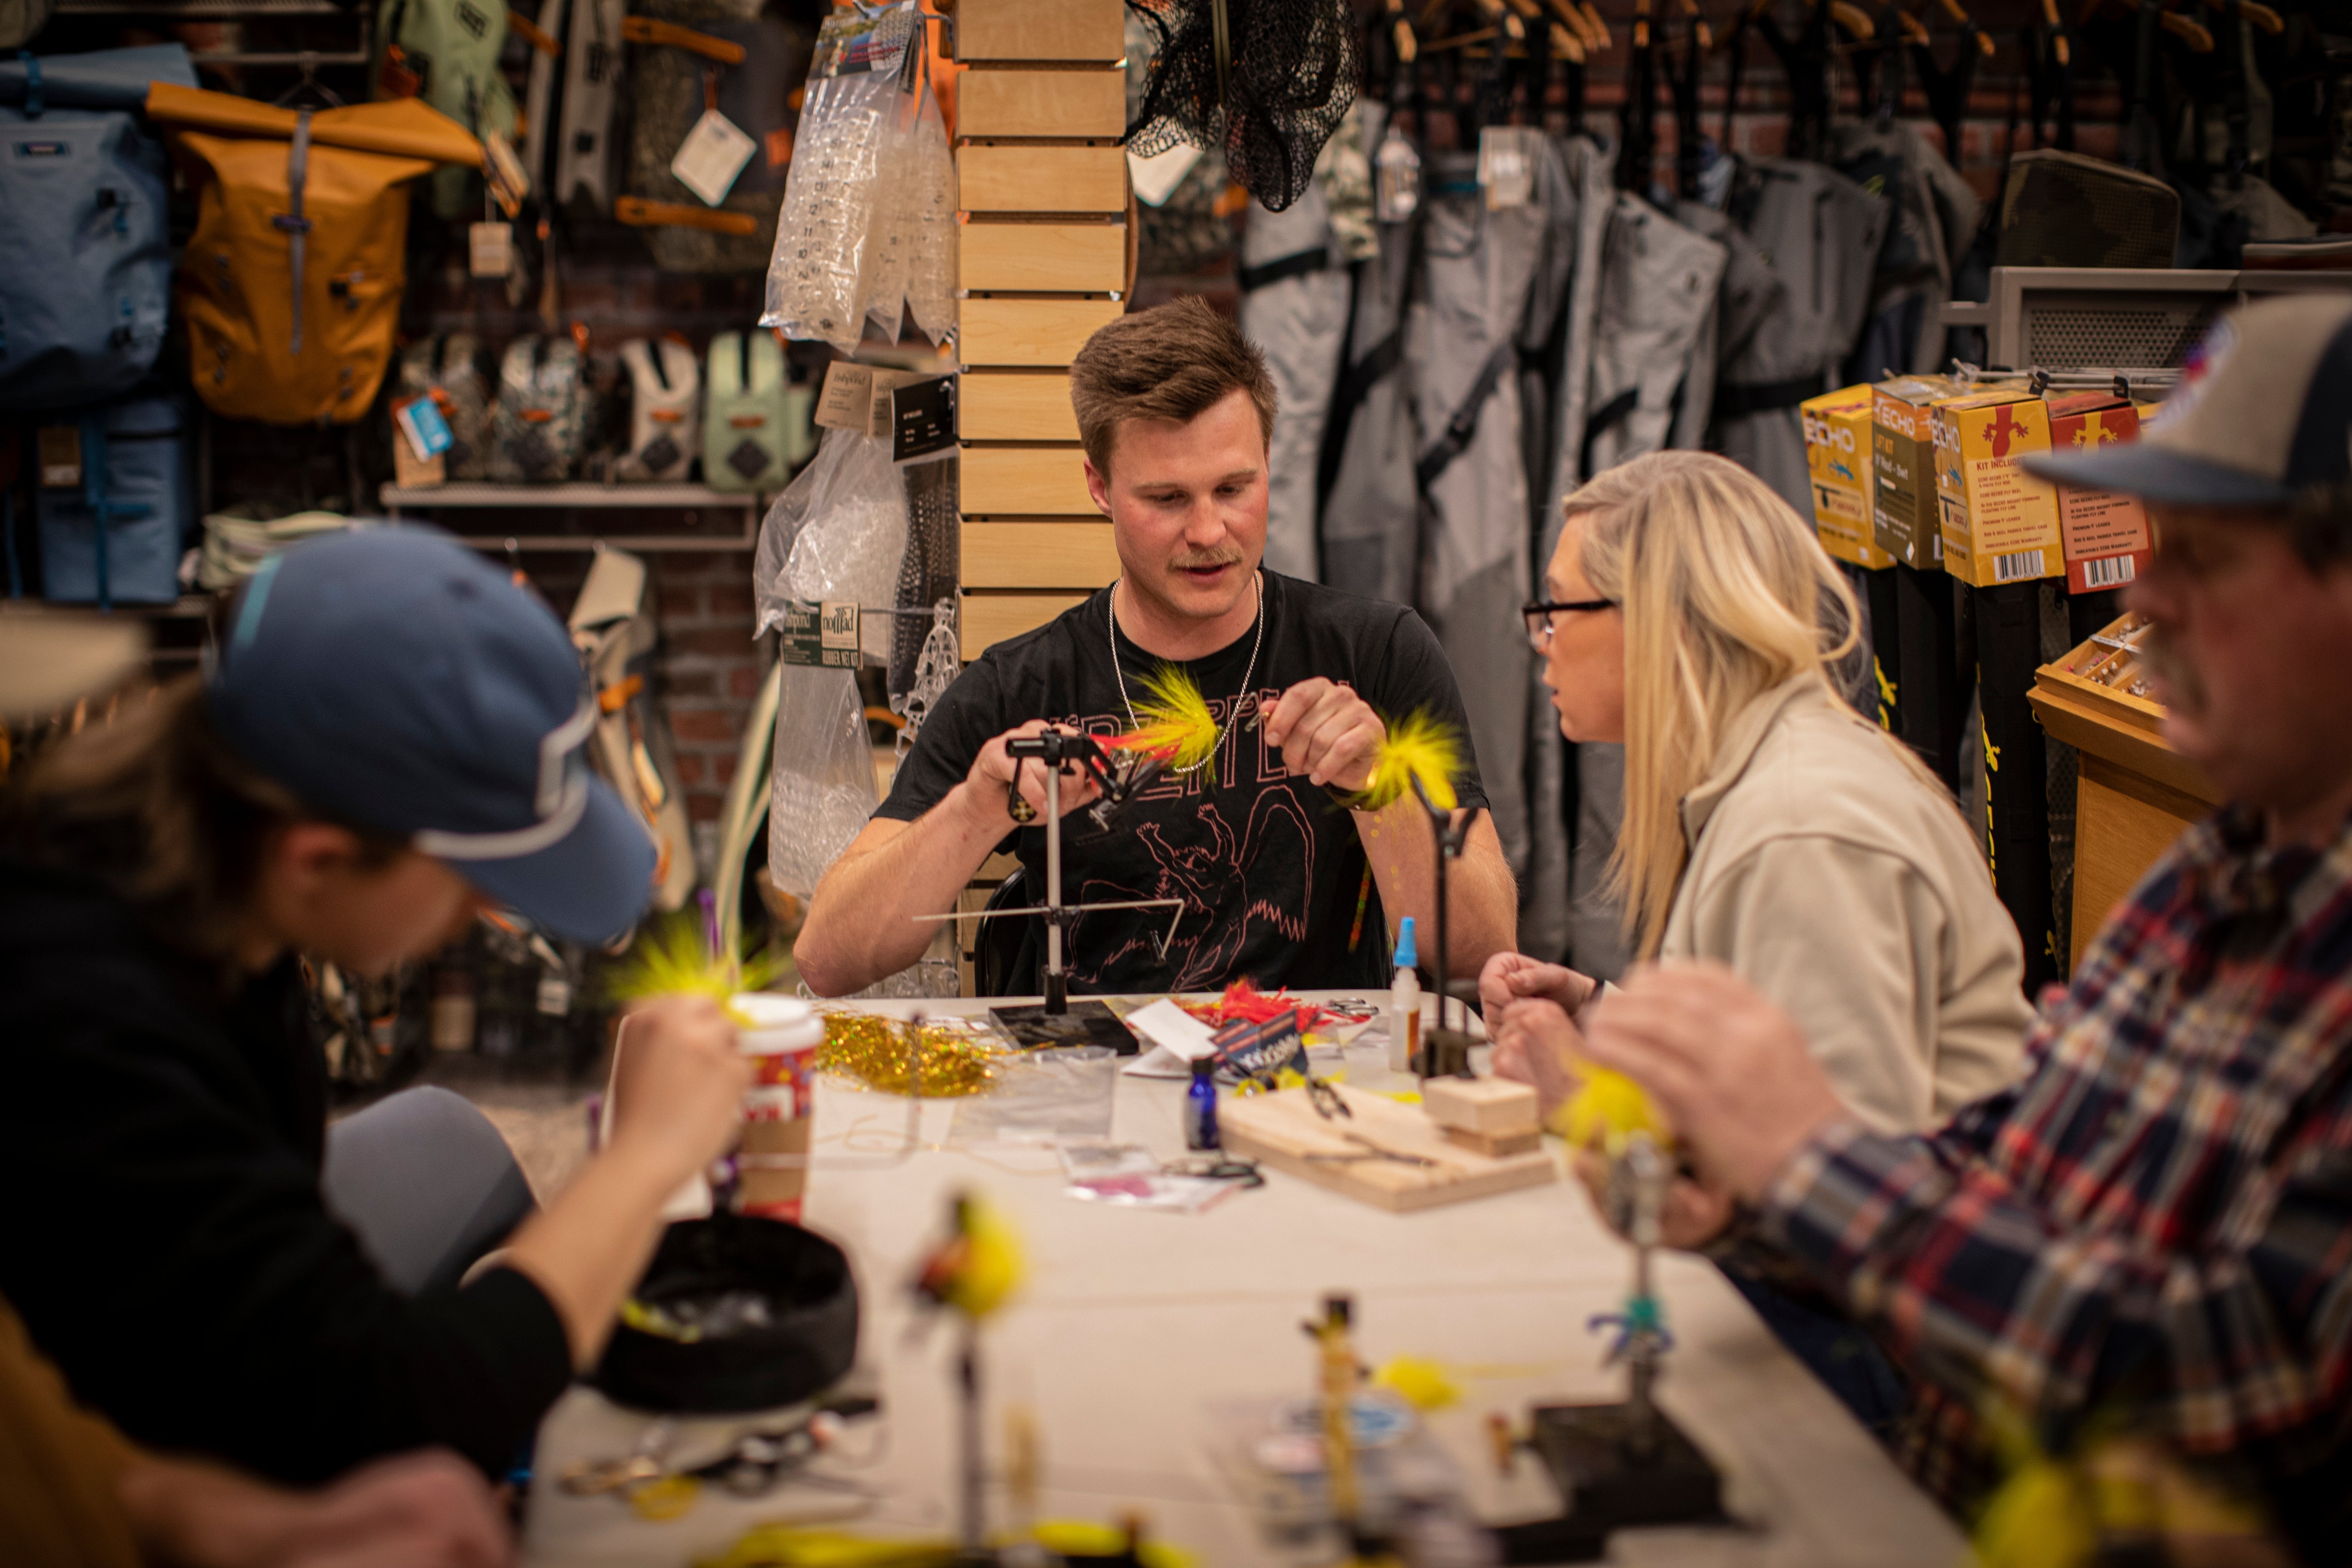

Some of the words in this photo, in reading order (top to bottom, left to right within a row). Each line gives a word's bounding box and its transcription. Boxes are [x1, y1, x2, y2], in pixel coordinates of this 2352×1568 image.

[1804, 416, 1856, 454] ECHO
[1882, 406, 1916, 437] ECHO
[1931, 419, 1961, 453] ECHO
[1976, 461, 1988, 471] KIT
[841, 650, 850, 667] NET
[850, 651, 859, 668] KIT
